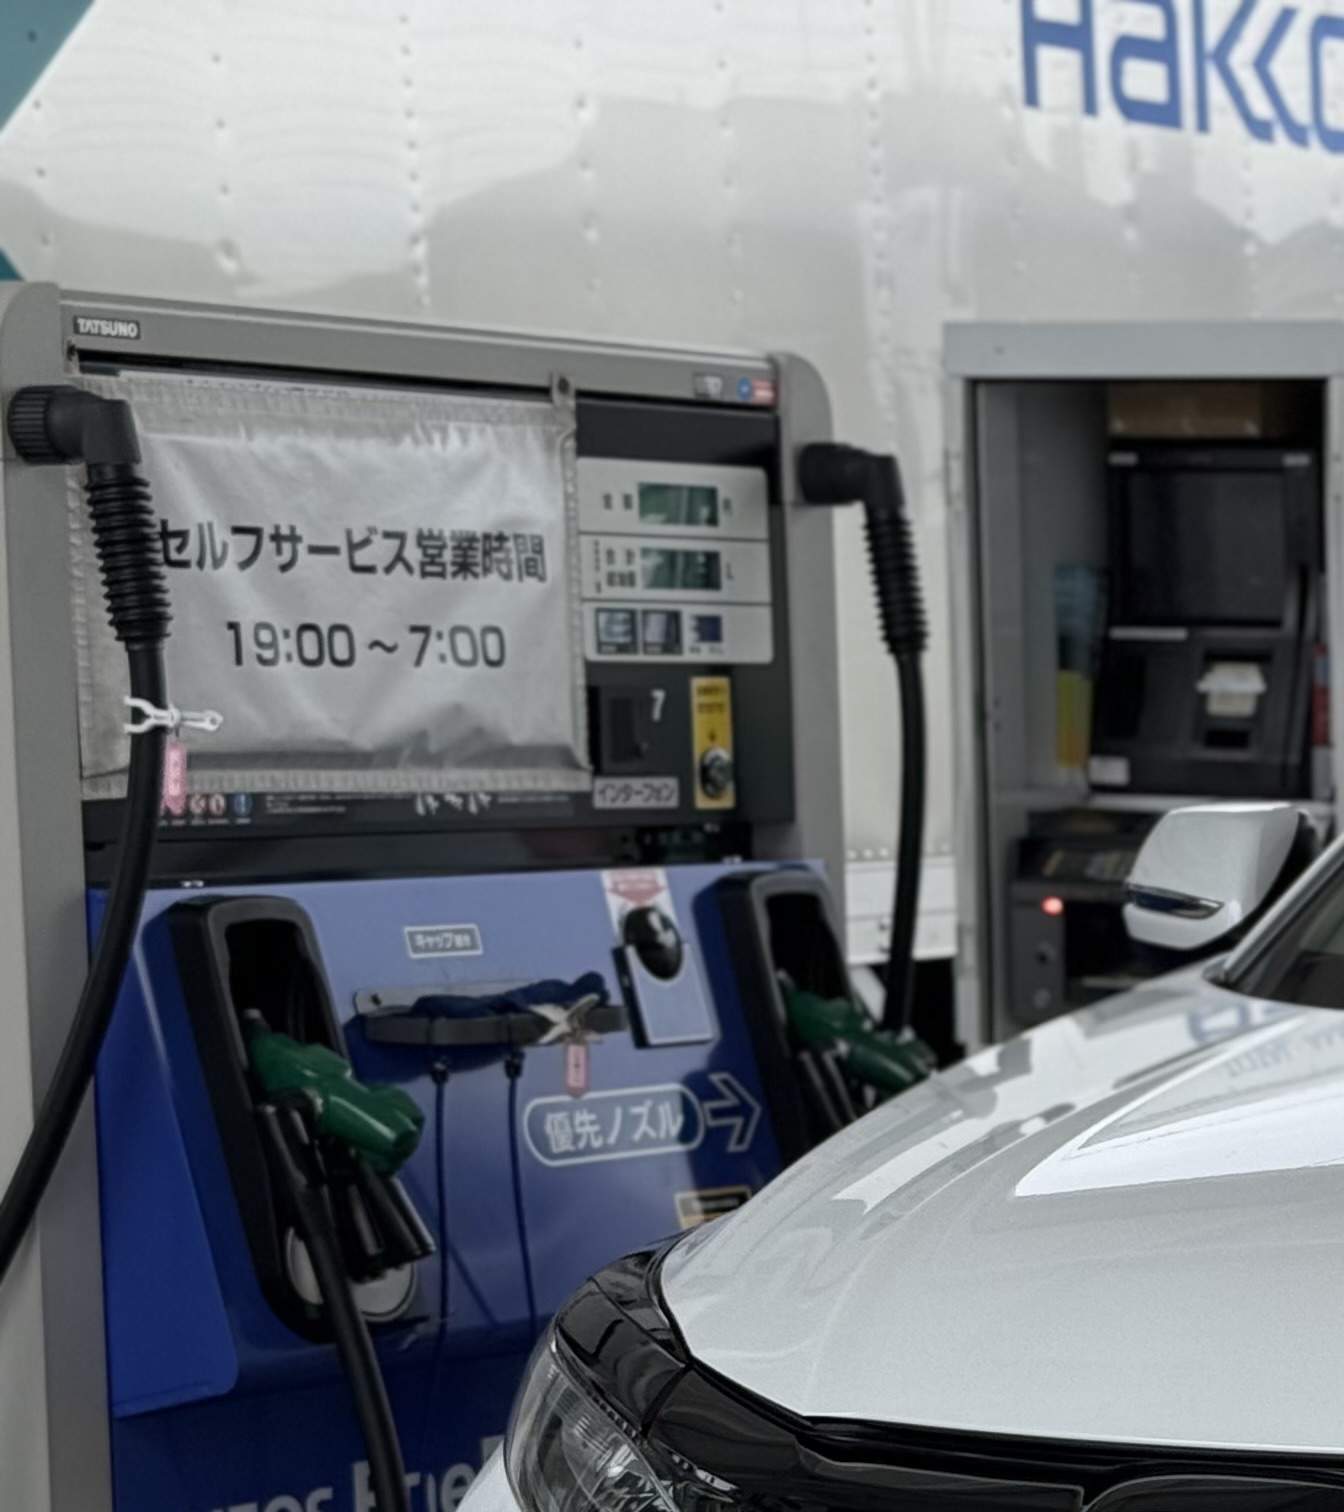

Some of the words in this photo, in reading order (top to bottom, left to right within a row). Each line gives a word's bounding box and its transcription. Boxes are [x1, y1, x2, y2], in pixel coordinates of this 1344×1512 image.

[76, 317, 139, 338] TATSUNO
[159, 518, 548, 582] セルフサービス営業時間
[651, 689, 666, 722] 7
[544, 1100, 684, 1154] 優先ノズル
